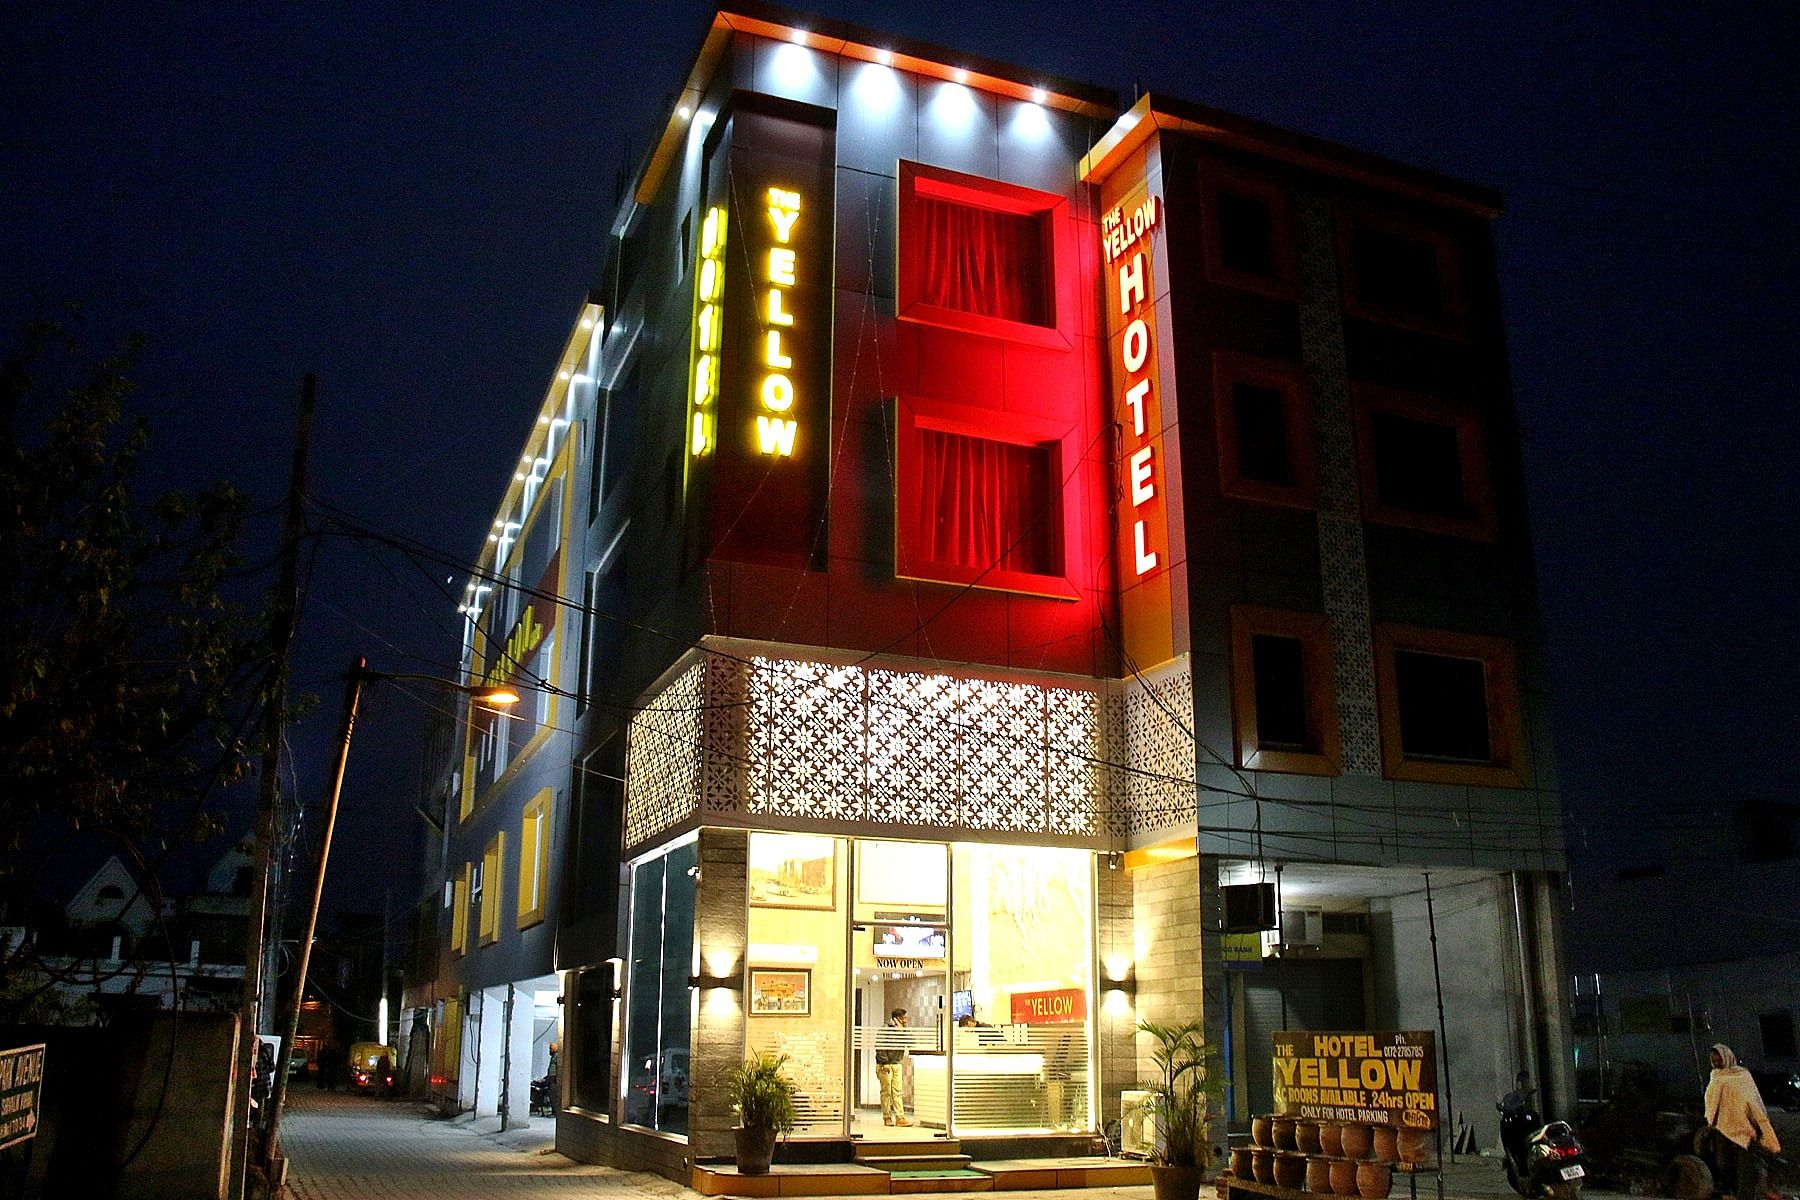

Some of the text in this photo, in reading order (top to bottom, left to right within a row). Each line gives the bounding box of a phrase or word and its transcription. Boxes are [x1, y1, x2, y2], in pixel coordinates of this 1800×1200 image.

[1102, 206, 1120, 234] THE
[1103, 195, 1156, 264] YELLOW
[756, 208, 799, 456] YELLOW
[1119, 253, 1158, 576] HOTEL
[877, 959, 924, 969] NOW OPEN
[1032, 996, 1073, 1016] YELLOW
[1276, 1044, 1294, 1056] THE
[1314, 1036, 1382, 1058] HOTEL
[1274, 1058, 1422, 1090] YELLOW
[1288, 1088, 1318, 1104] ROOMS
[1320, 1089, 1366, 1107] AVAILABLE
[1405, 1092, 1434, 1110] OPEN
[1301, 1106, 1388, 1124] ONLY FOR HOTEL PARKING
